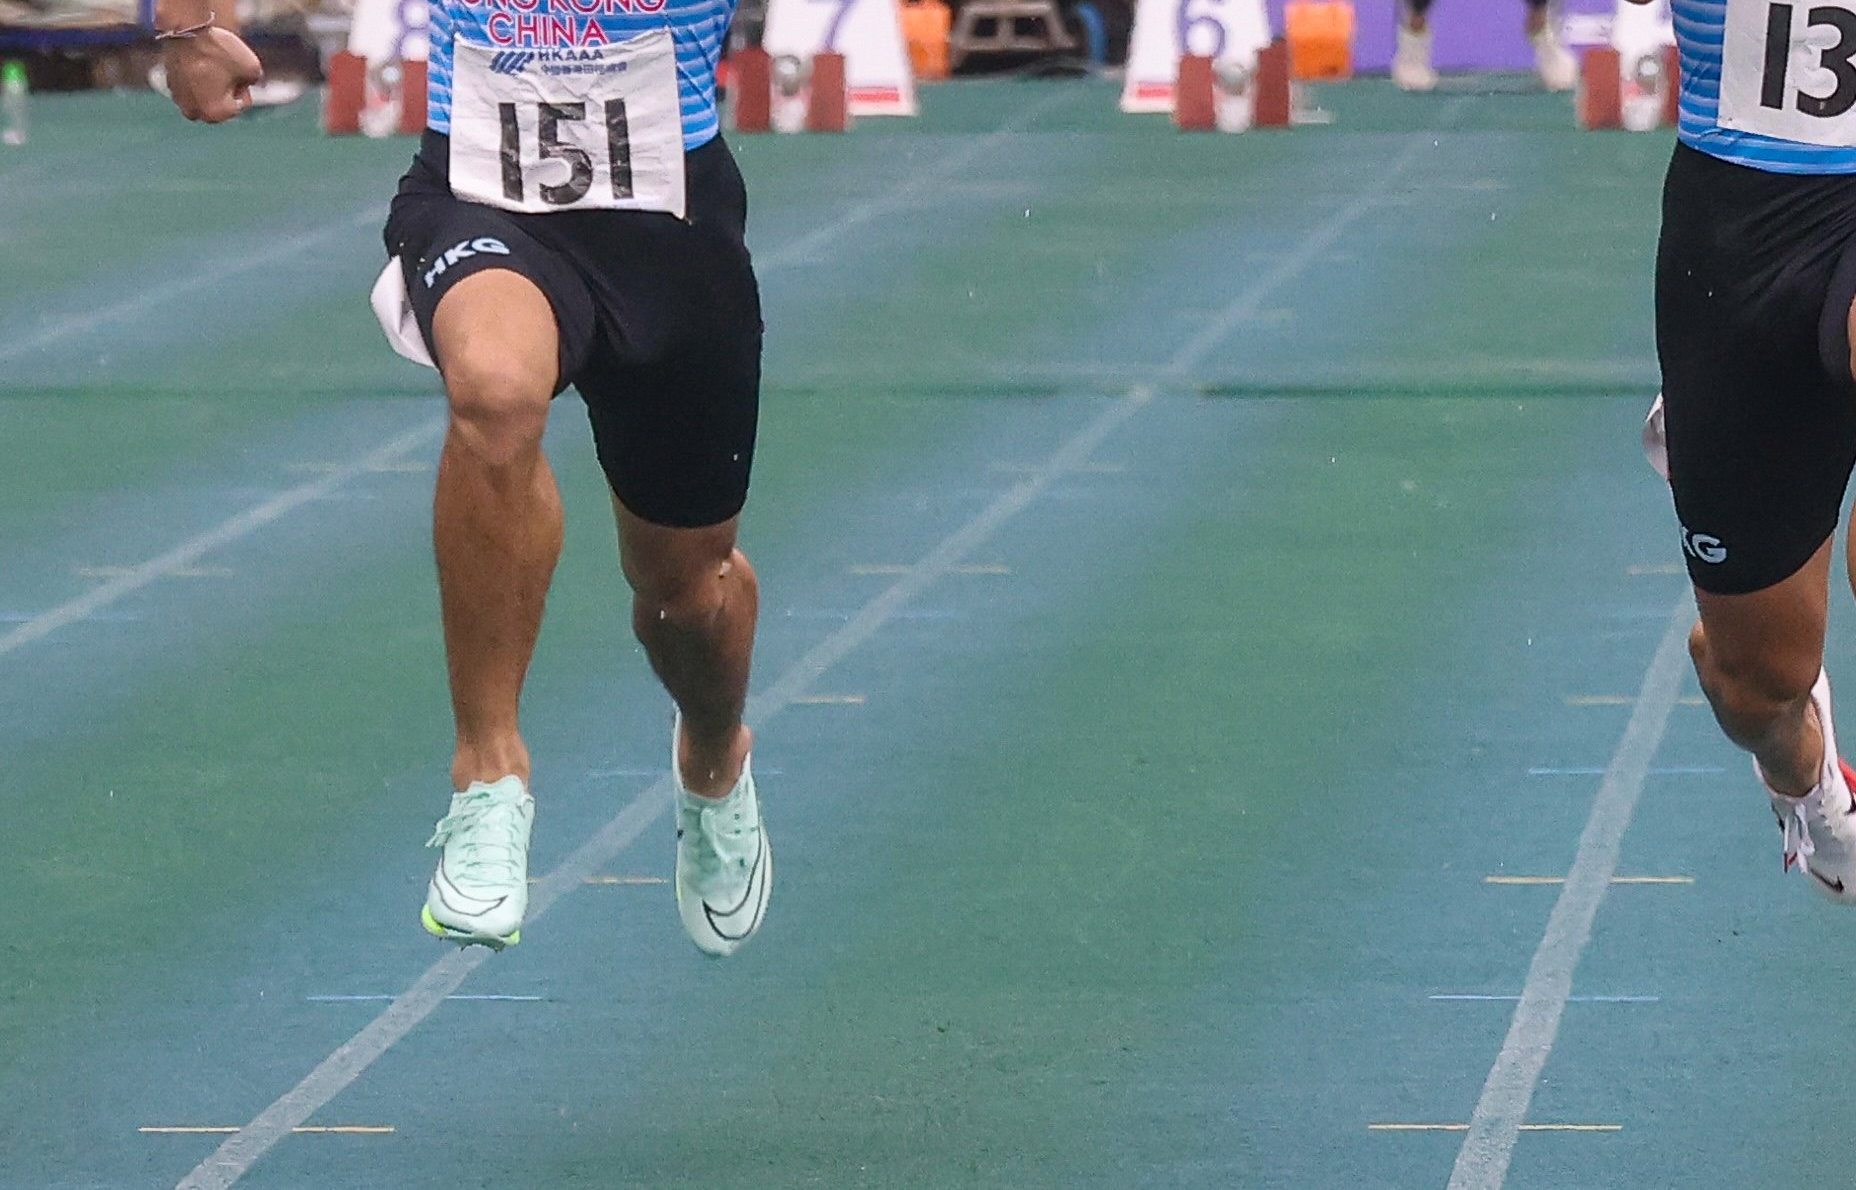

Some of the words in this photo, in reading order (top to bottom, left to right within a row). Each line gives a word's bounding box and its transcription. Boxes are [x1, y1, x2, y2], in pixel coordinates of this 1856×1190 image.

[488, 12, 609, 47] CHINA
[498, 98, 634, 205] 151
[424, 238, 511, 288] HKG
